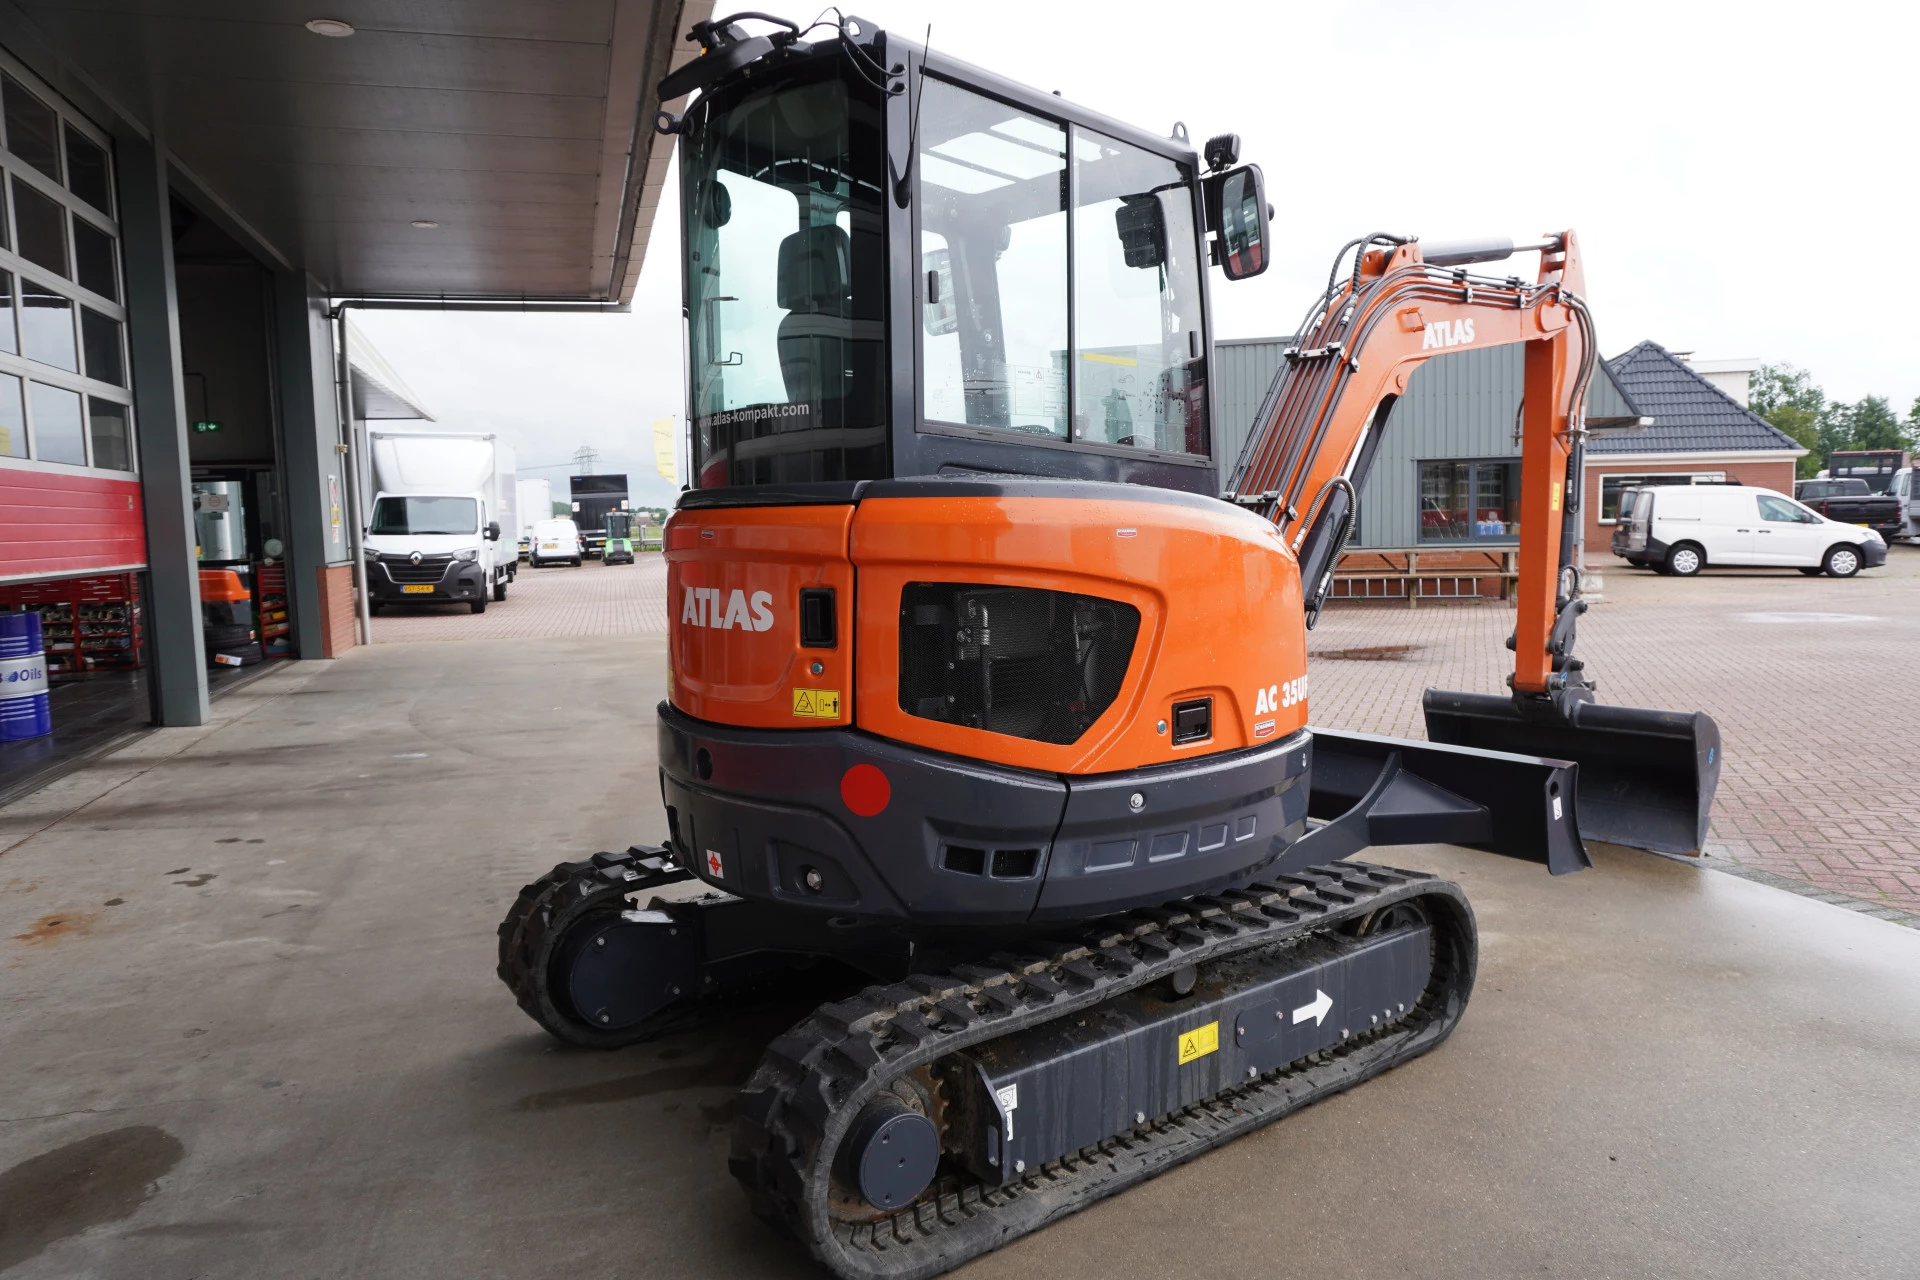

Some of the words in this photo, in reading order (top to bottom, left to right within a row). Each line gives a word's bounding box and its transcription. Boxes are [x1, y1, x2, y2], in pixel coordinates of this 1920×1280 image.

[1422, 317, 1475, 350] ATLAS
[682, 586, 774, 632] ATLAS
[1255, 684, 1278, 716] AC
